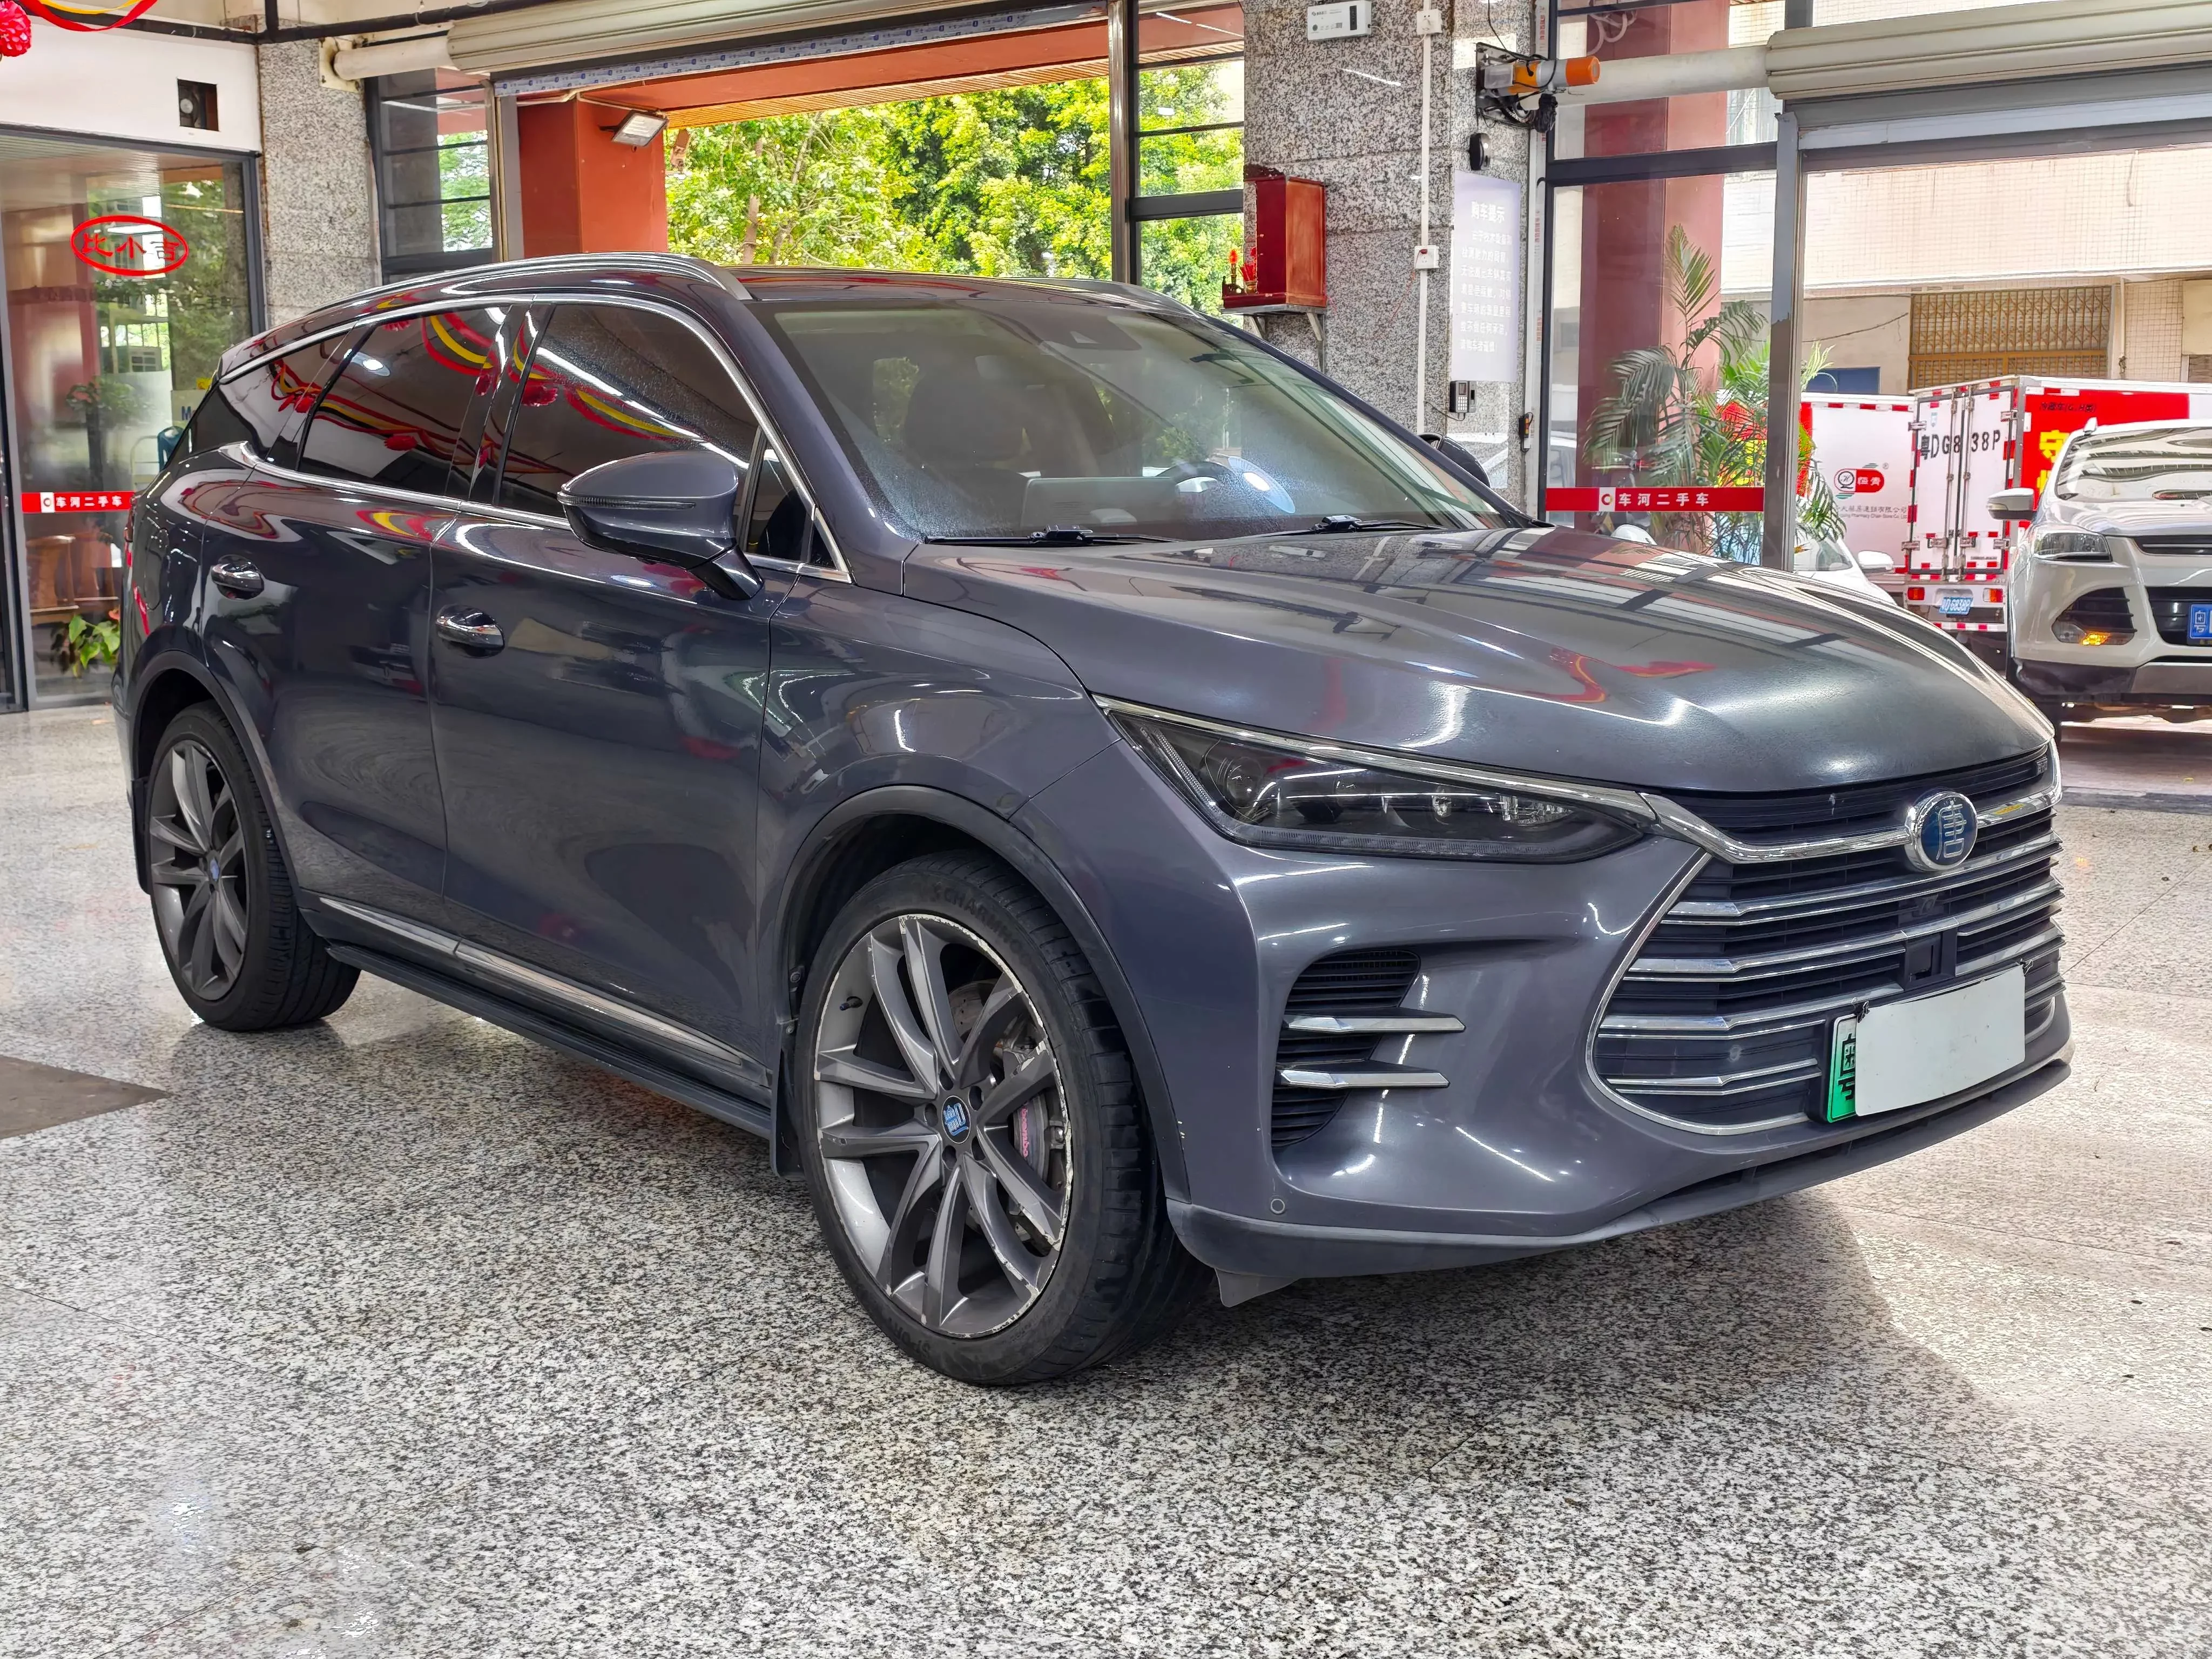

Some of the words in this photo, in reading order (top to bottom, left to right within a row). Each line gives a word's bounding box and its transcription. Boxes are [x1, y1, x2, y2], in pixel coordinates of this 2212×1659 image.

[56, 495, 122, 508] 车河二手车
[1618, 493, 1709, 507] 车河二手车
[2194, 610, 2212, 634] 粤
